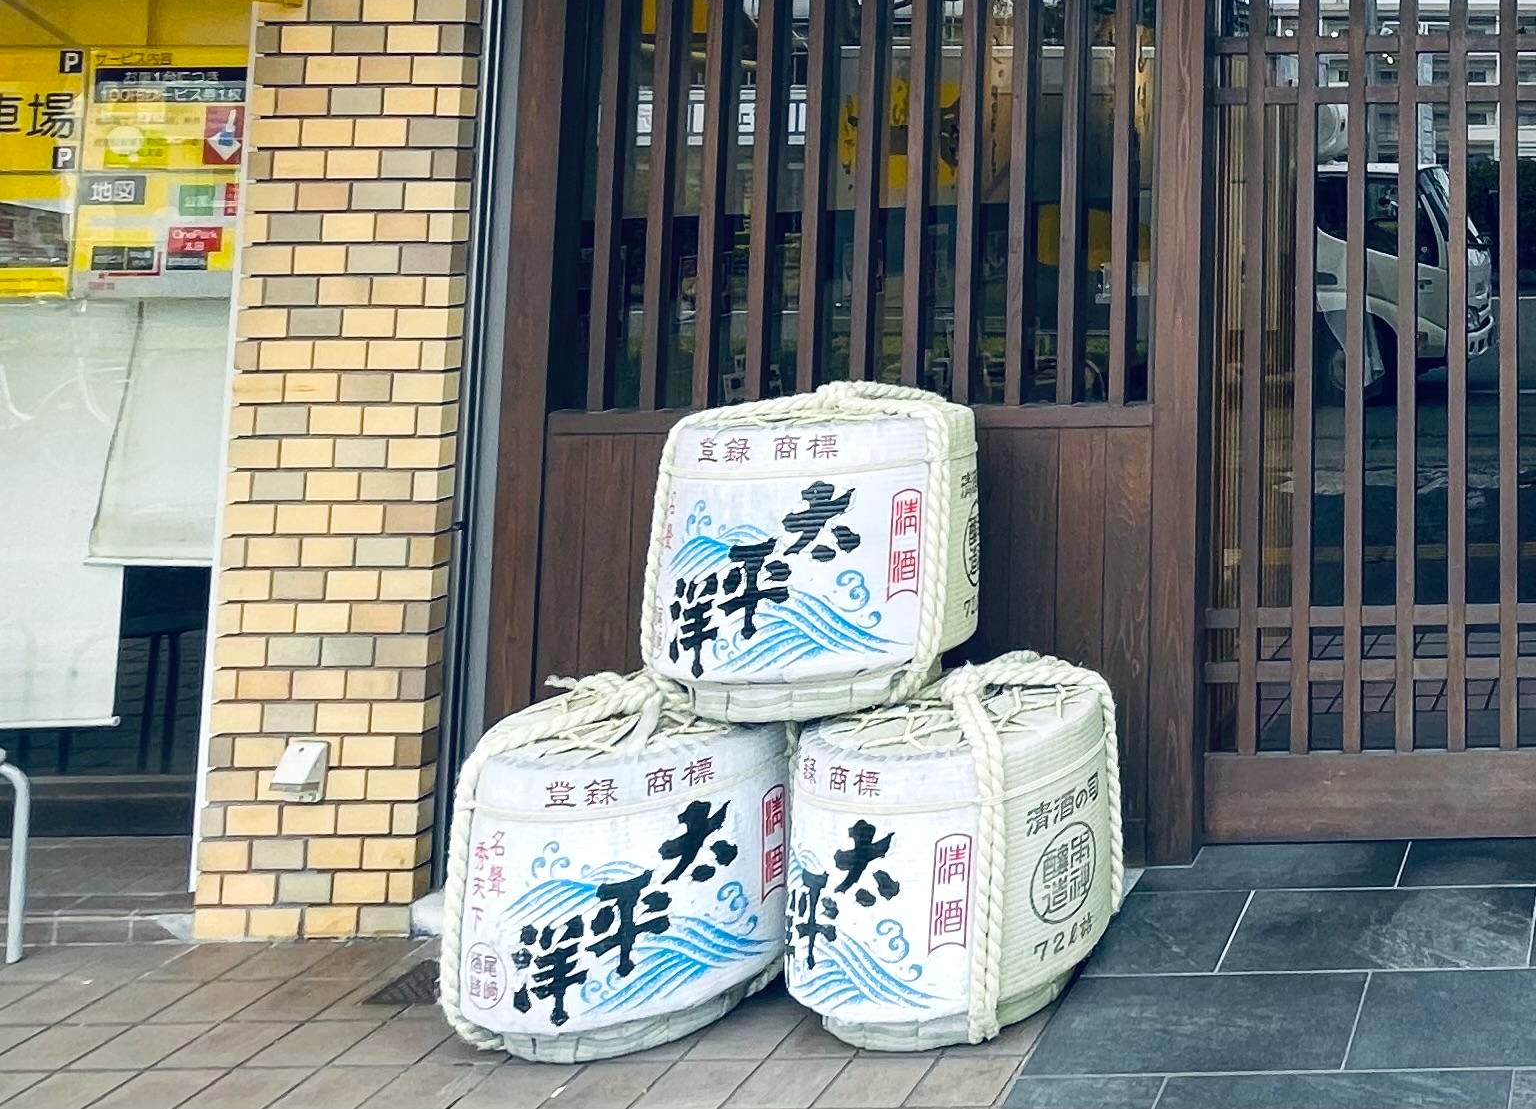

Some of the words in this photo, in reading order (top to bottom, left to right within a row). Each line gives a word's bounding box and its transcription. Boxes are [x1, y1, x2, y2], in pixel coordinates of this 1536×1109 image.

[64, 52, 79, 72] P
[57, 148, 72, 168] P
[90, 180, 135, 202] 地図
[892, 497, 919, 584] 清酒
[669, 480, 862, 679] 太平洋
[544, 755, 715, 809] 登録商標
[511, 799, 739, 1027] 太平洋
[933, 843, 967, 937] 清酒
